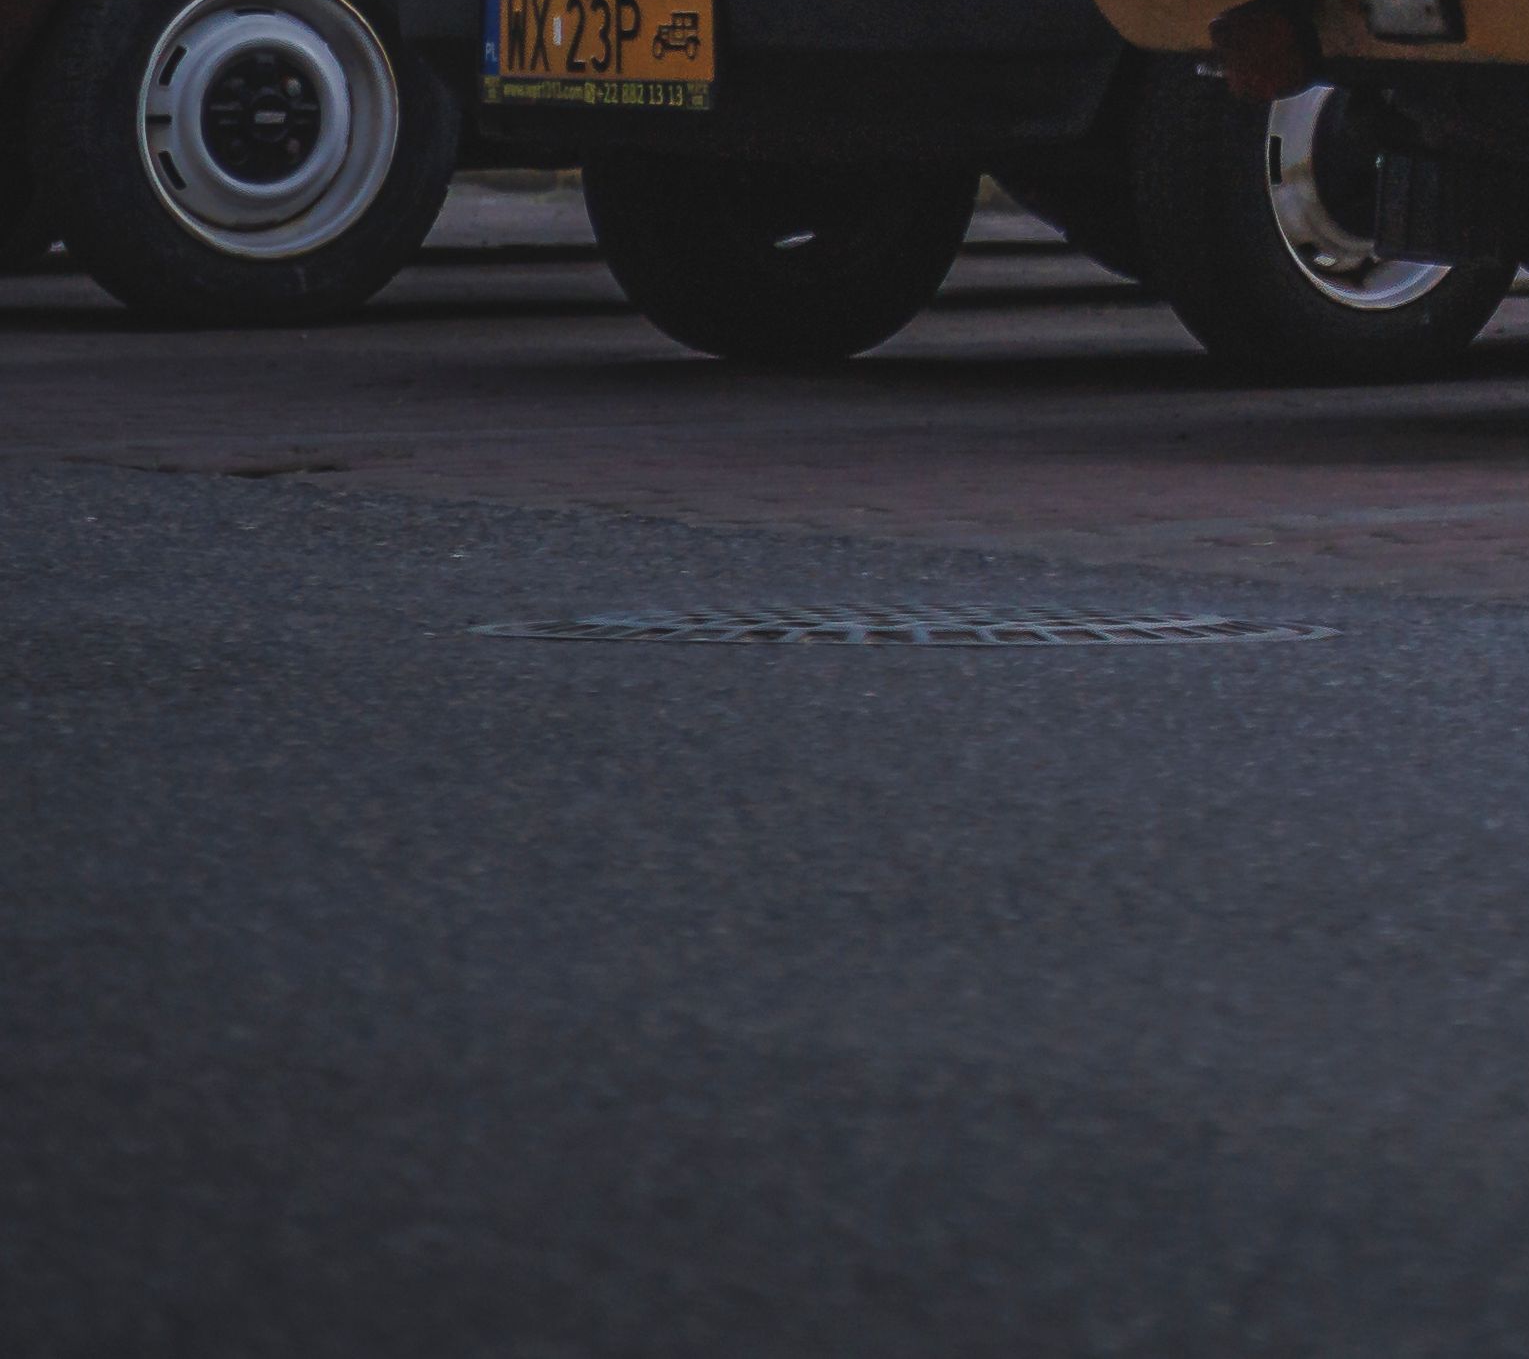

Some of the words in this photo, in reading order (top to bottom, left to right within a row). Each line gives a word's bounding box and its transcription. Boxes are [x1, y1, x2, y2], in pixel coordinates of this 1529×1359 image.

[484, 41, 498, 62] PL
[648, 84, 664, 105] 13
[668, 84, 684, 107] 13
